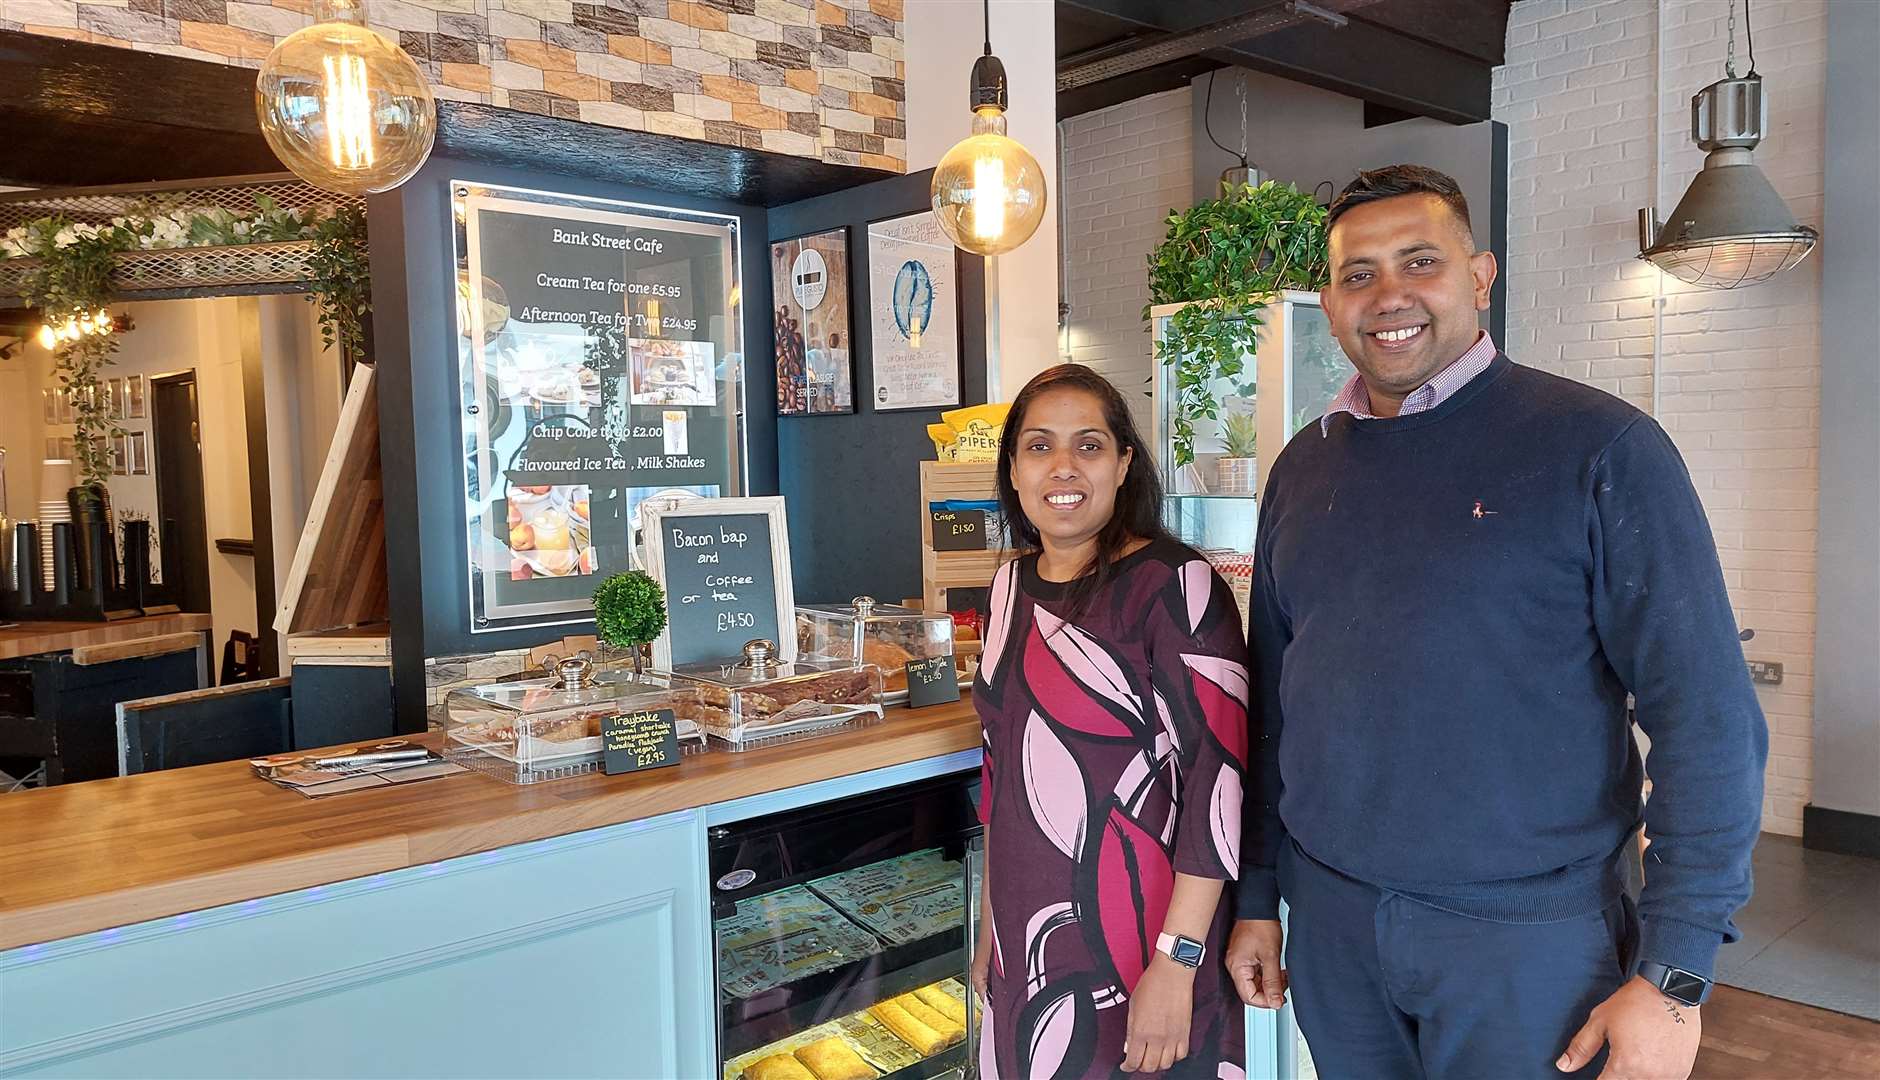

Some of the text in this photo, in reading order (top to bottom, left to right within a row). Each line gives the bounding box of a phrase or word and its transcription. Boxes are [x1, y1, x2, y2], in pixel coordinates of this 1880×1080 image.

[552, 228, 663, 254] Bank Street Cafe
[536, 273, 681, 298] Cream Tea for one £5.95
[520, 306, 586, 323] Afternoon
[589, 310, 612, 326] Tea
[613, 312, 632, 330] for
[662, 316, 697, 331] £24.95
[532, 424, 564, 440] Chip
[567, 424, 598, 439] Cone
[600, 427, 613, 438] to
[633, 426, 663, 438] £2.00
[516, 457, 580, 472] Flavoured
[583, 457, 602, 471] Ice
[604, 457, 626, 471] Tea
[637, 456, 663, 469] Milk
[665, 455, 706, 469] Shakes
[672, 525, 748, 549] Bacon bap
[697, 551, 720, 564] and
[705, 574, 754, 588] Coffee
[682, 589, 738, 604] or tea
[716, 612, 755, 633] £4.50
[907, 663, 927, 673] lemon
[610, 711, 660, 727] Traybake
[605, 727, 637, 737] caramel
[637, 750, 665, 767] £2.95
